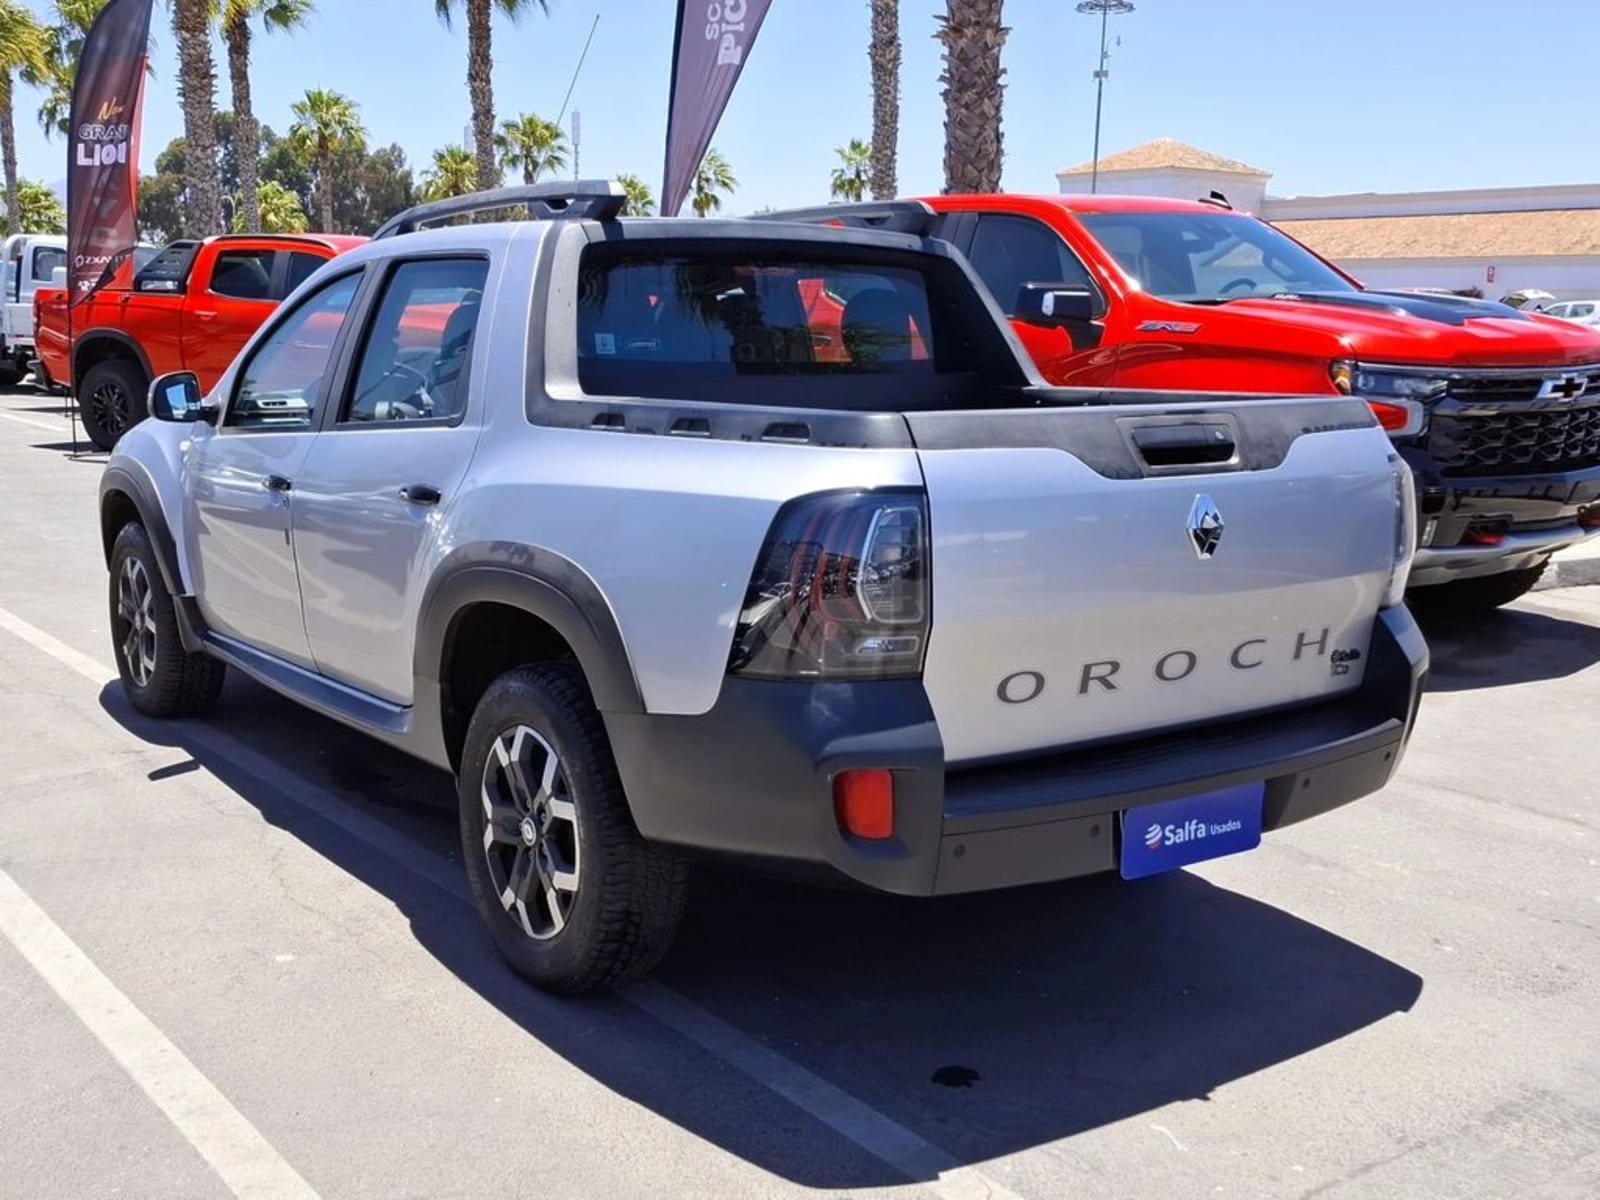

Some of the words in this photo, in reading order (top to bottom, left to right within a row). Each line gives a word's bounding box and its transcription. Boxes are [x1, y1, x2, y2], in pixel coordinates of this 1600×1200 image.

[996, 628, 1329, 704] OROCH
[1164, 819, 1206, 845] Salfa
[1210, 820, 1241, 835] Usados
